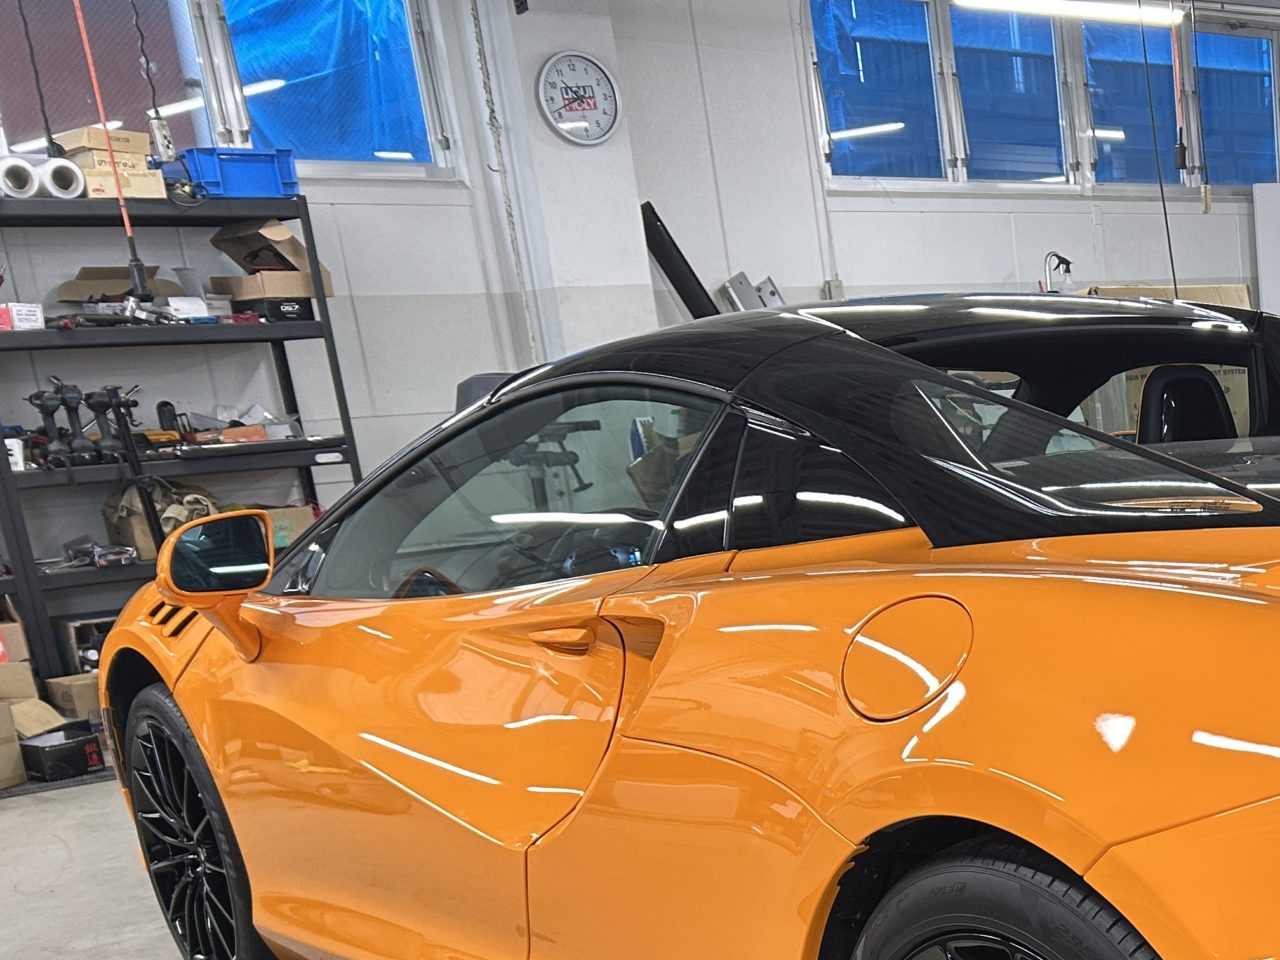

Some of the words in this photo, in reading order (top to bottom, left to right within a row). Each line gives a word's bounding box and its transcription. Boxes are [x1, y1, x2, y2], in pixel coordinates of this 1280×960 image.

[568, 63, 576, 72] 12
[556, 69, 564, 77] 11
[565, 98, 597, 111] MOLY
